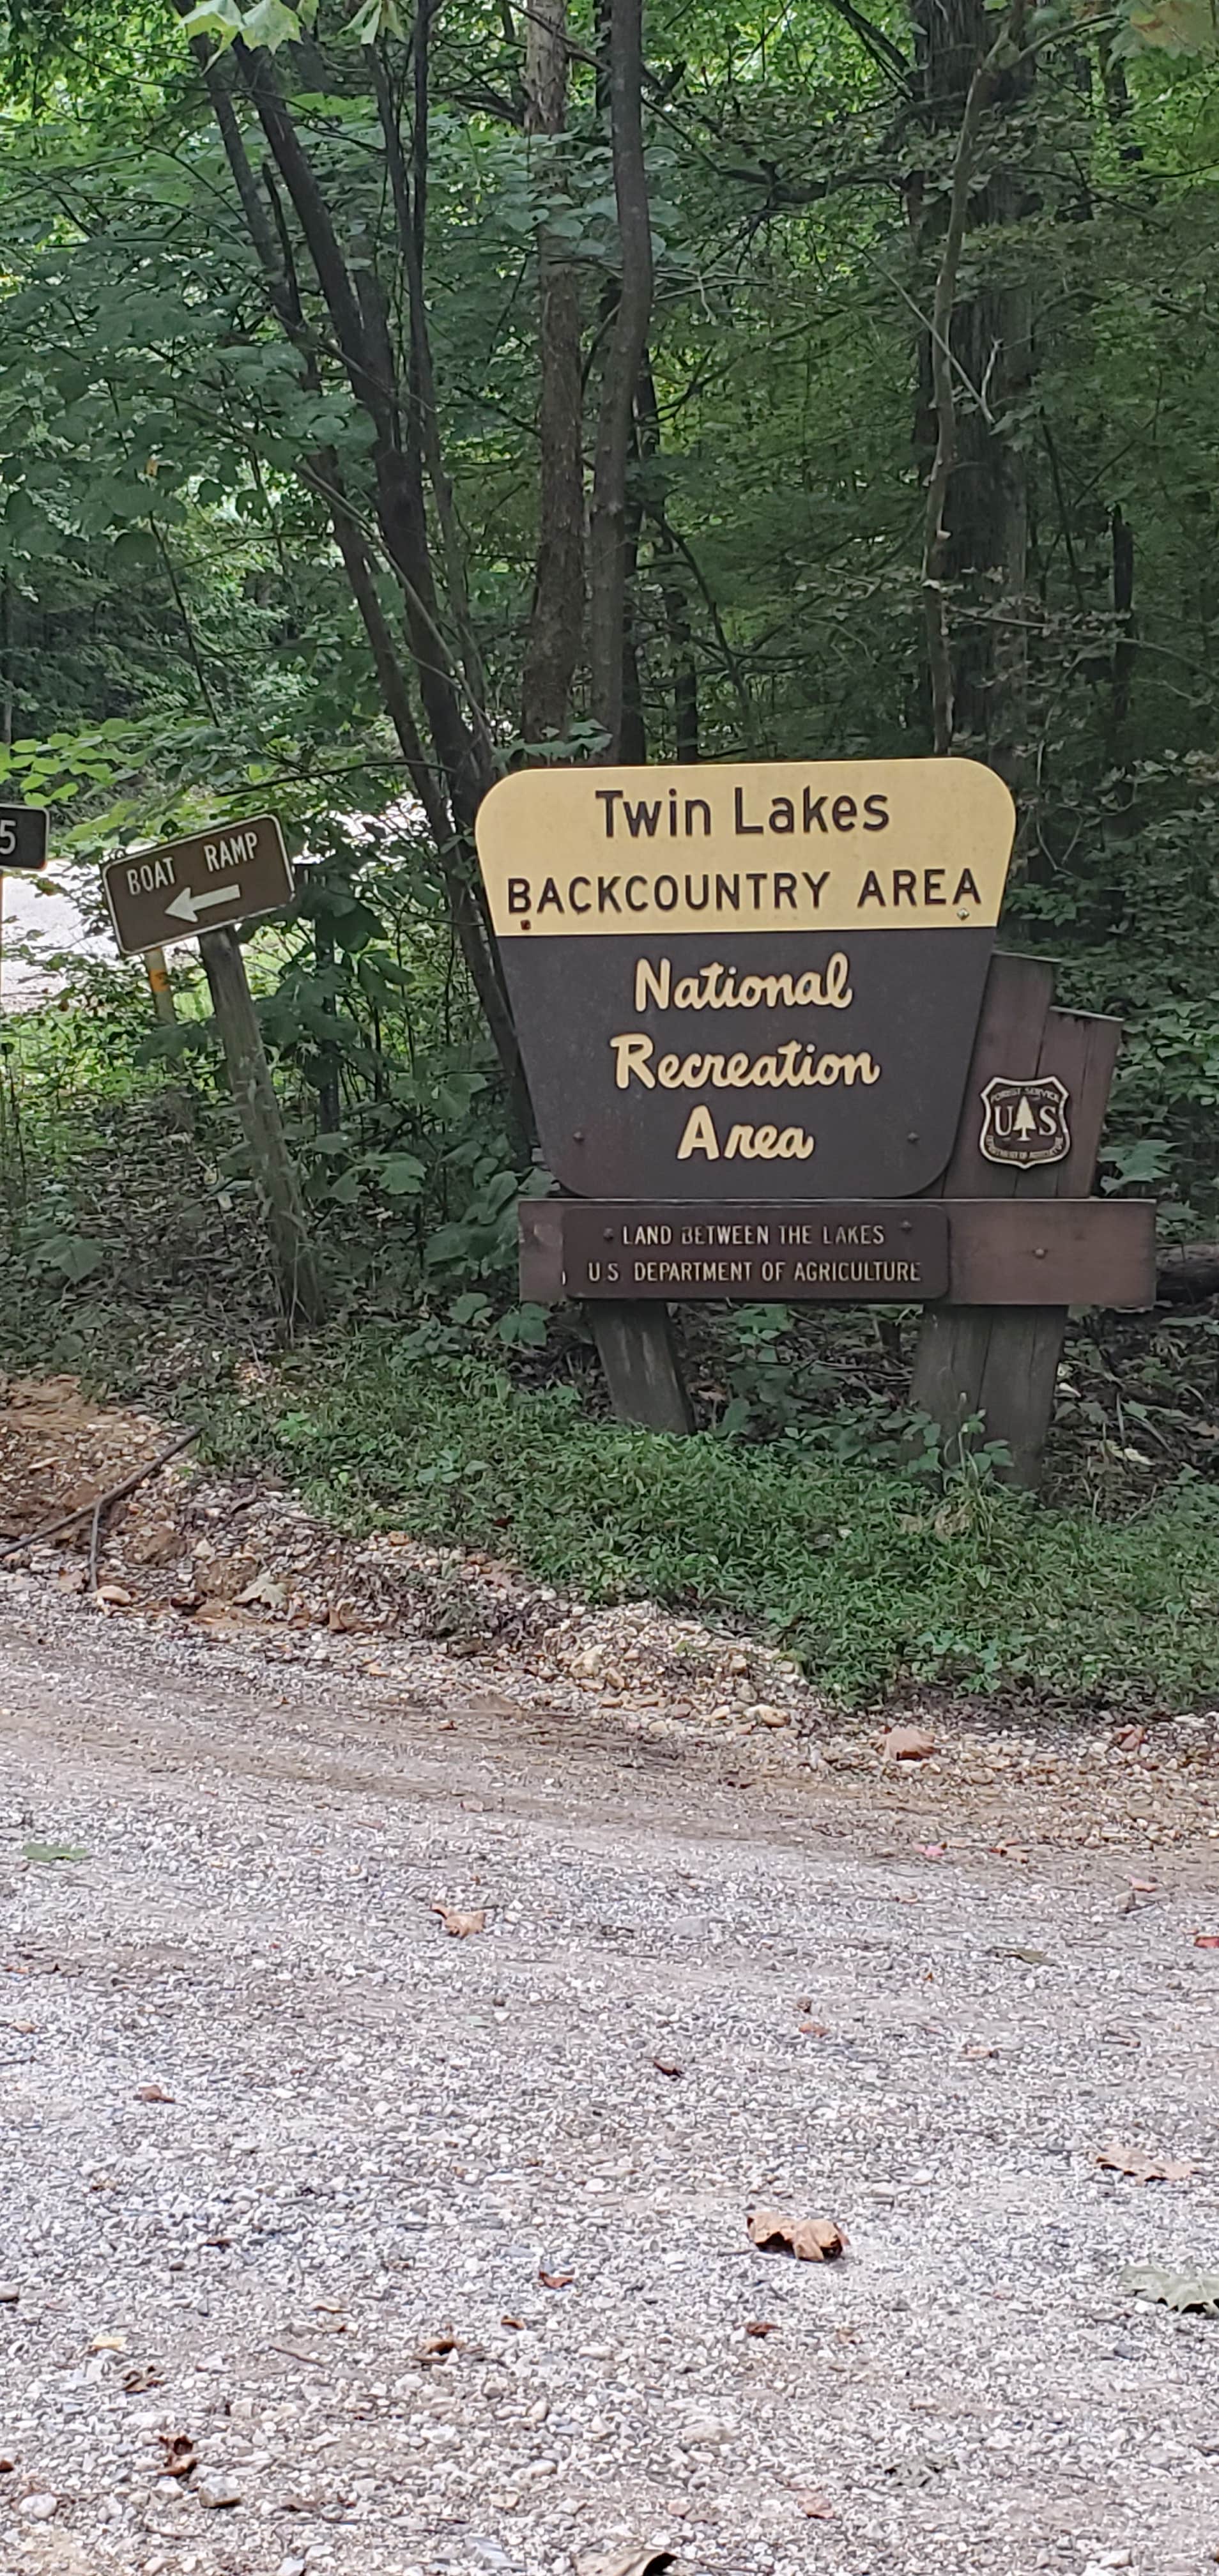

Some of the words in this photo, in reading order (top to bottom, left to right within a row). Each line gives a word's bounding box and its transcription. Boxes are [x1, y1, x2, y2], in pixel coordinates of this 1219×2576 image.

[595, 790, 711, 838] Twin
[735, 786, 890, 834] Lakes
[126, 857, 176, 895] BOAT
[203, 832, 257, 872] RAMP
[507, 871, 831, 914] BACKCOUNTRY
[857, 868, 982, 907] AREA
[634, 951, 853, 1012] National
[610, 1033, 881, 1089] Recreation
[677, 1105, 815, 1160] Area
[622, 1225, 671, 1245] LAND
[681, 1225, 768, 1245] BETWEEN
[778, 1225, 812, 1243] THE
[822, 1224, 884, 1244] LAKES
[634, 1262, 751, 1282] DEPARTMENT
[762, 1262, 785, 1281] OF
[794, 1261, 921, 1282] AGRICULTURE
